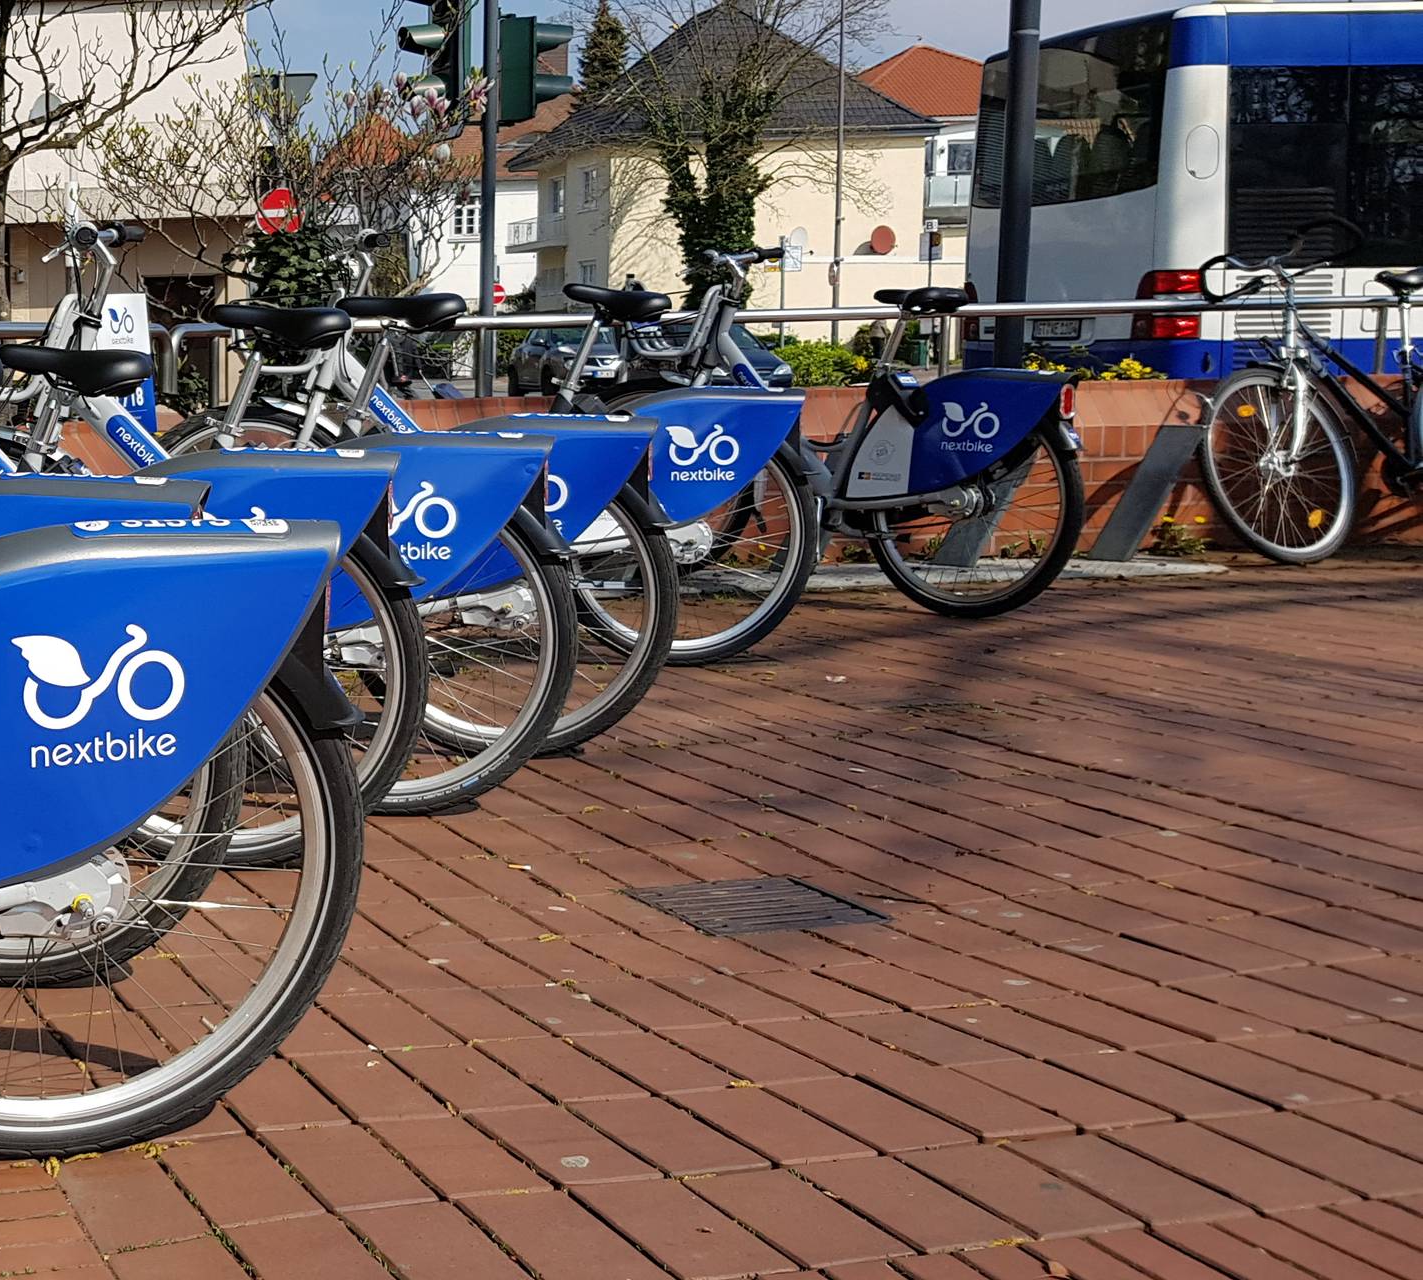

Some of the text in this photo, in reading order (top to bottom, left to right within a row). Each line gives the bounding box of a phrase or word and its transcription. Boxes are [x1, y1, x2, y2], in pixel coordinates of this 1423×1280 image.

[370, 396, 407, 432] nextbike
[116, 426, 156, 467] nextbik
[940, 439, 994, 453] nextbike
[670, 467, 735, 481] nextbike
[400, 541, 451, 561] tbike
[31, 728, 177, 768] nextbike
